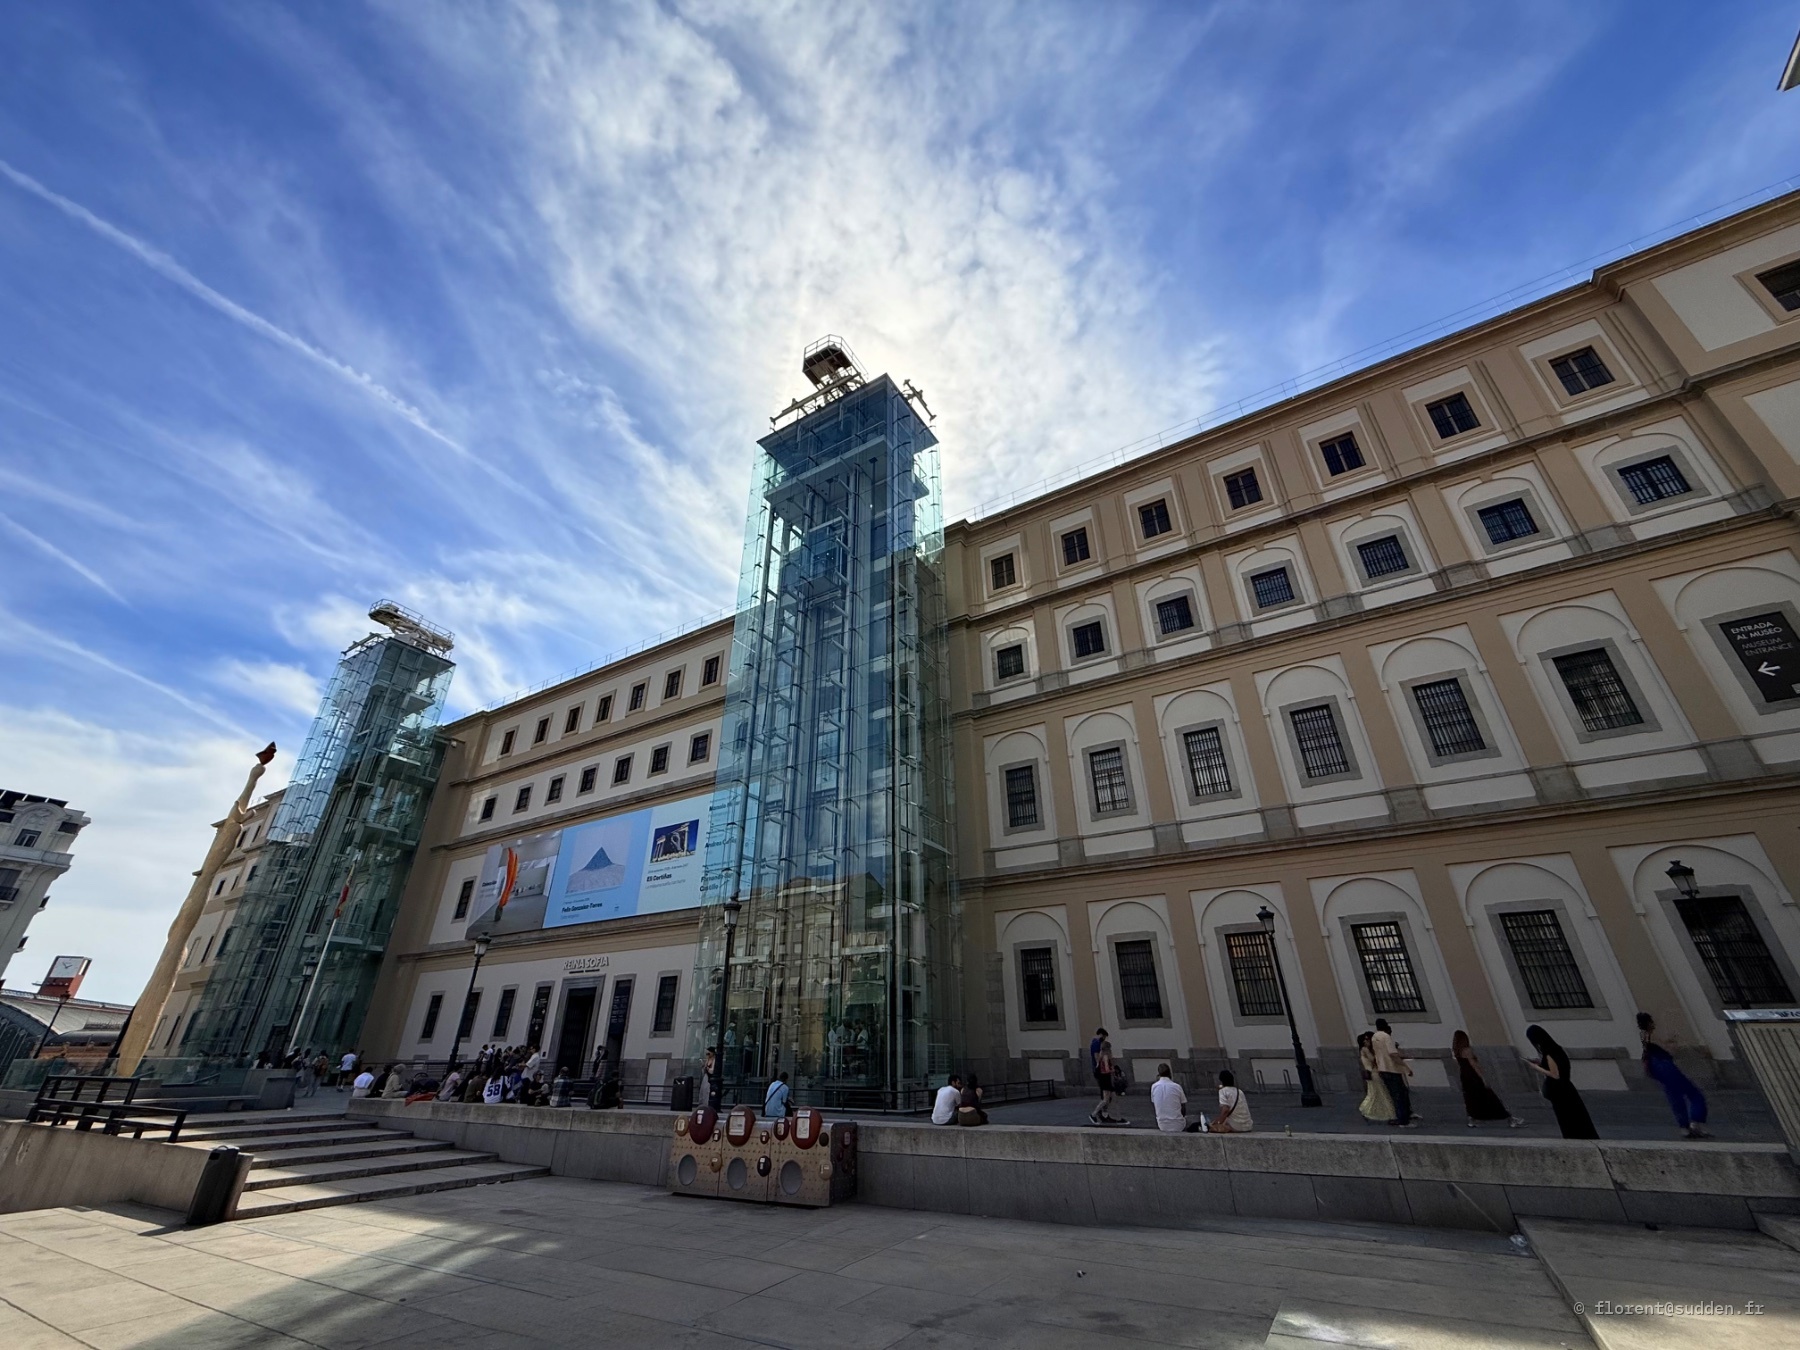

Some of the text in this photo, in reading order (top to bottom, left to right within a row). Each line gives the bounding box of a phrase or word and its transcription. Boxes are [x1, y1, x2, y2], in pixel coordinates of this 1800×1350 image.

[1731, 621, 1774, 634] ENTRADA
[1737, 627, 1782, 641] AL MUSEO
[1742, 638, 1782, 649] MUSEUM
[1745, 642, 1794, 656] ENTRANCE
[563, 959, 585, 971] REINA
[487, 1083, 501, 1097] 58
